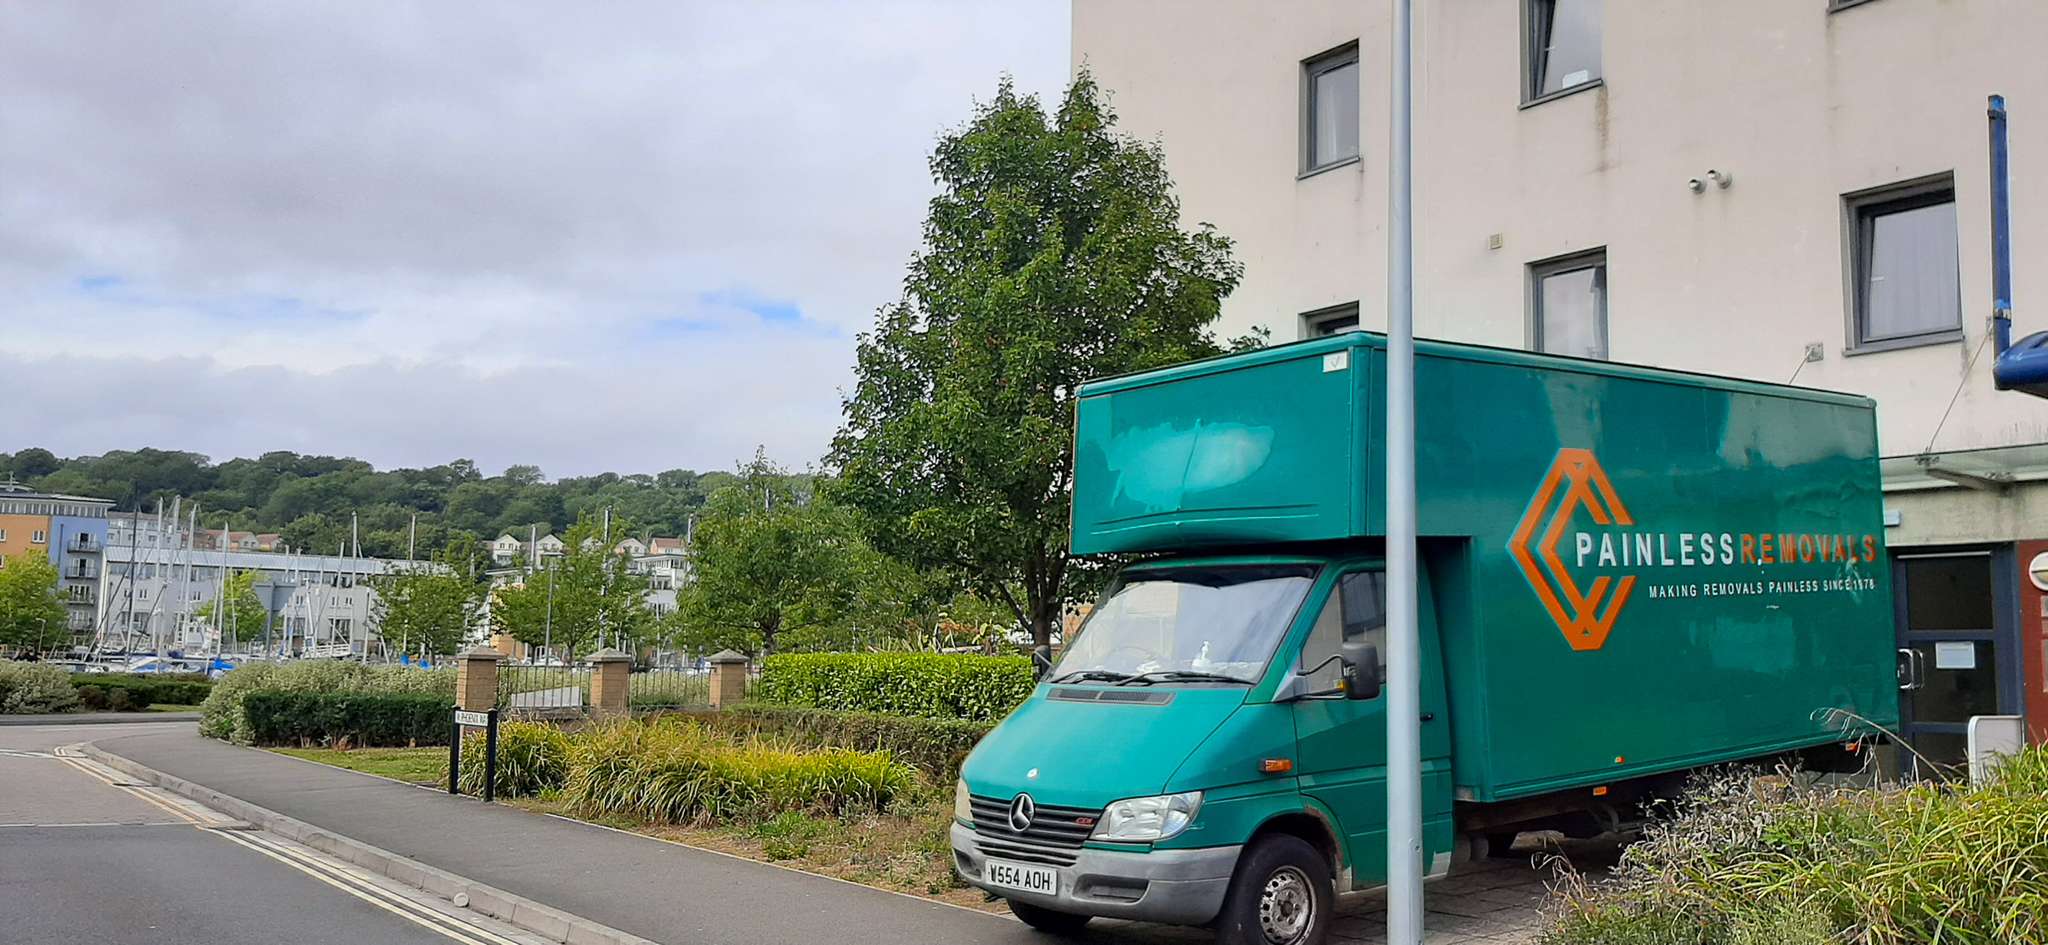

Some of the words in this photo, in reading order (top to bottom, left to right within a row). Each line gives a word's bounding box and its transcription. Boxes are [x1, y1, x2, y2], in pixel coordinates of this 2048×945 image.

[1575, 531, 1736, 568] PAINLESS
[1740, 533, 1878, 565] REMOVALS
[1649, 584, 1697, 598] MAKING
[1703, 582, 1763, 596] REMOVALS
[1768, 580, 1818, 593] PAINLESS
[1823, 579, 1850, 591] SINCE
[1024, 870, 1051, 890] AOH
